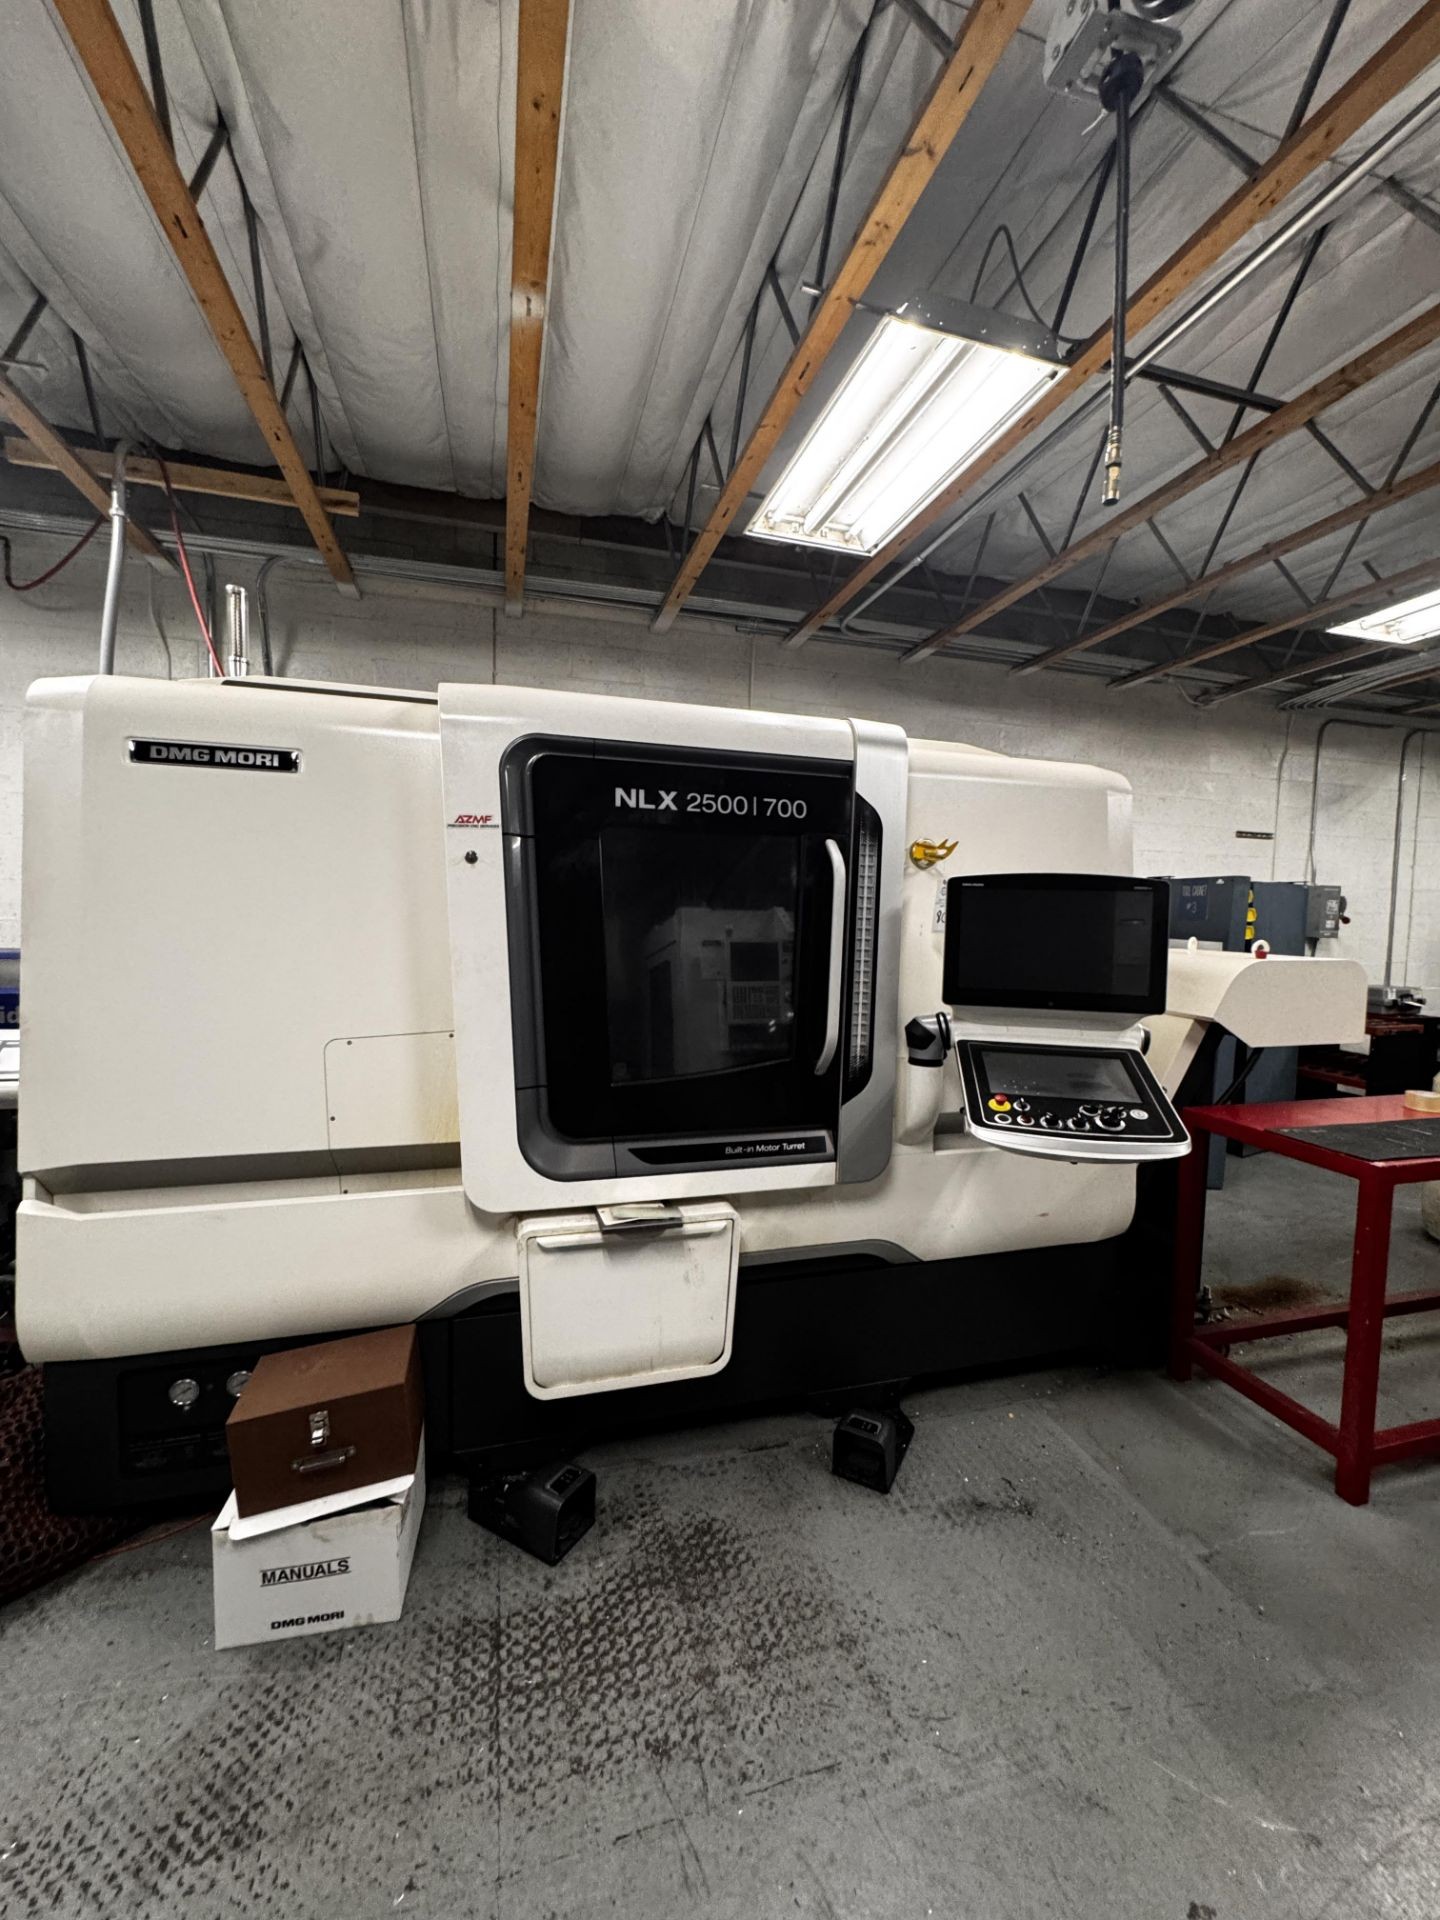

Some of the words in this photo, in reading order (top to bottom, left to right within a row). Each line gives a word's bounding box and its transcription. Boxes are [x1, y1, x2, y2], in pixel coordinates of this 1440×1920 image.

[150, 745, 210, 762] DMG
[214, 750, 279, 767] MORI
[614, 787, 678, 811] NLX
[454, 815, 493, 824] AZMF
[725, 1146, 755, 1155] Built-in
[755, 1144, 781, 1152] Motor
[782, 1142, 806, 1150] Turret
[261, 1559, 350, 1585] MANUALS
[271, 1617, 305, 1630] DMG
[307, 1610, 345, 1624] MORI
